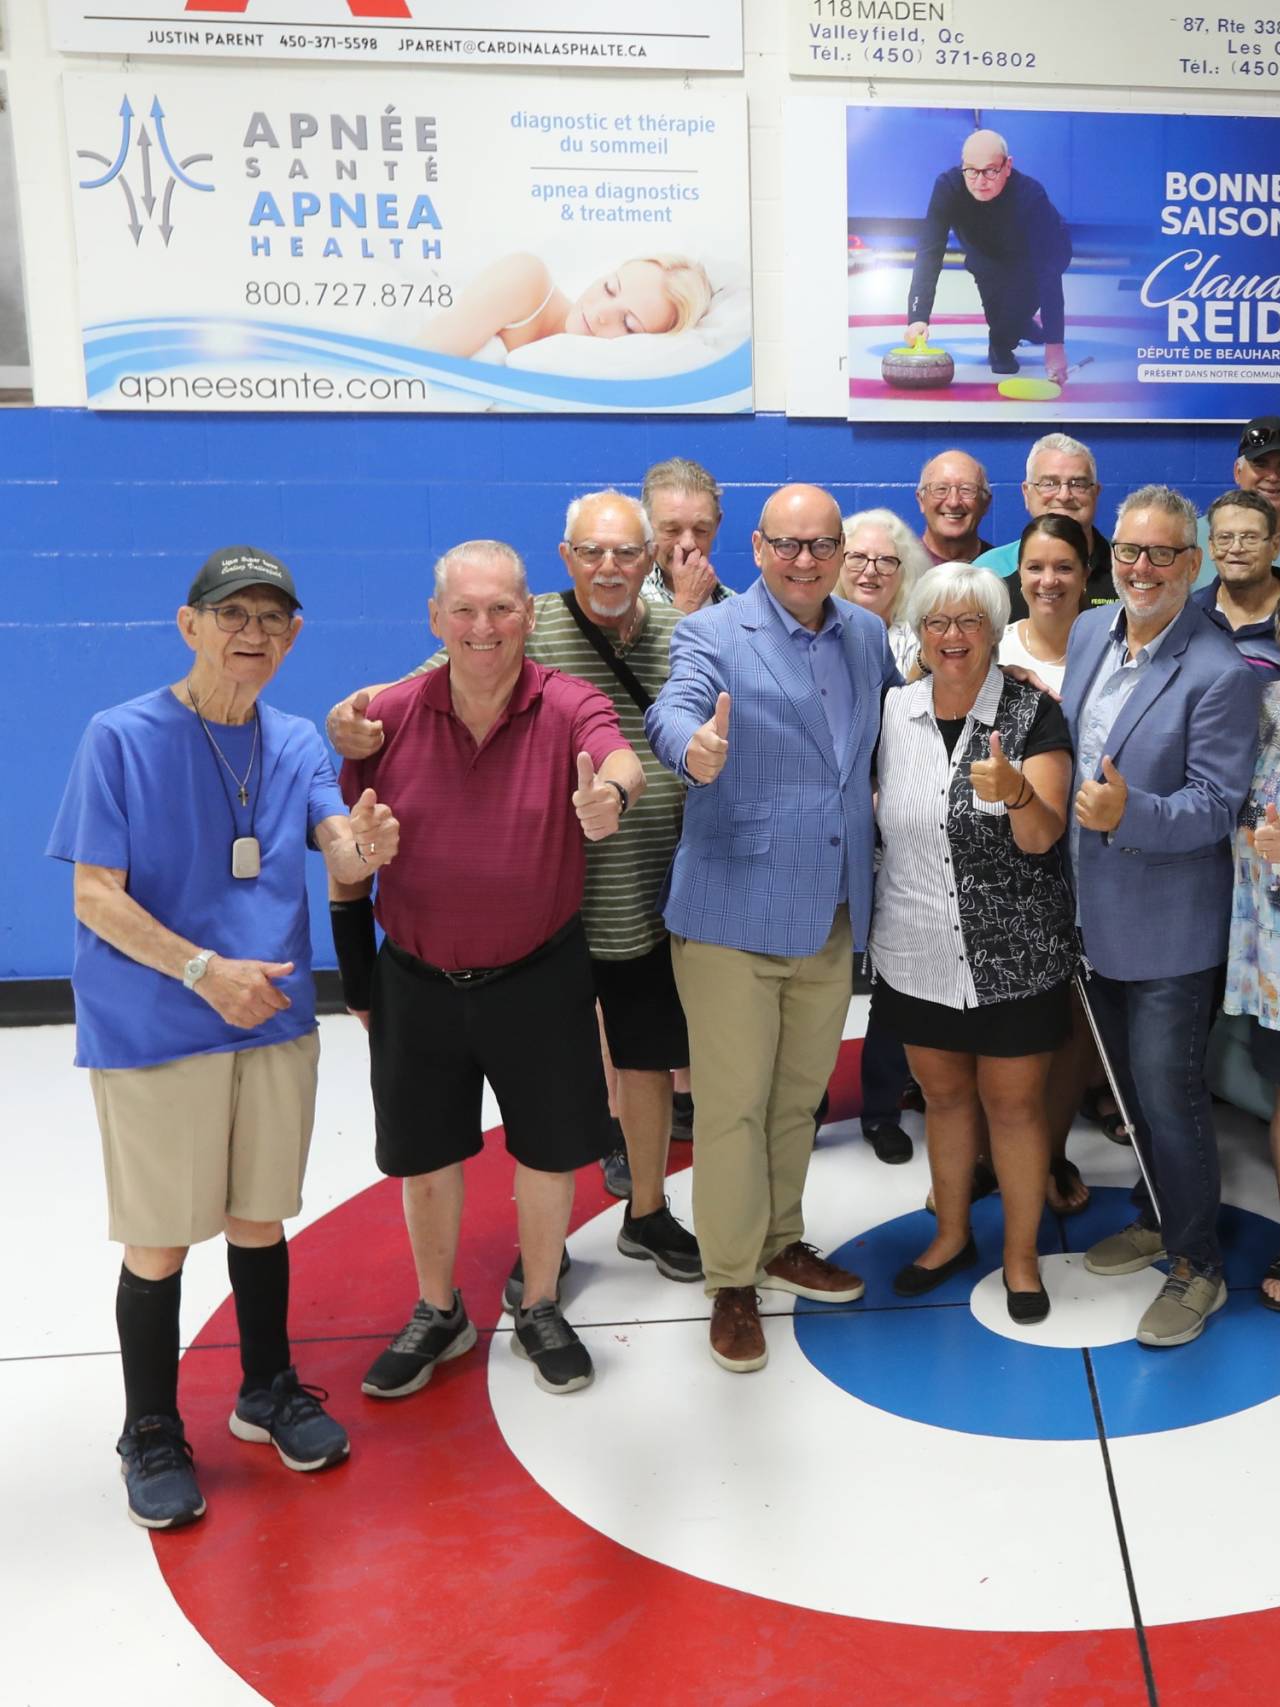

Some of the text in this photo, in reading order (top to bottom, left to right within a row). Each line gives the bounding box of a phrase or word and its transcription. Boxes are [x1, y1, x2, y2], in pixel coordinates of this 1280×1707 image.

[814, 0, 945, 21] 118 MADEN
[809, 23, 965, 44] Valleyfield, Qc
[1183, 18, 1209, 34] 87,
[1217, 18, 1246, 34] Rte
[148, 31, 648, 57] JUSTIN PARENT 450-371-5598 JPARENT@CARDINALASPHALTE.CA
[1228, 40, 1262, 54] Les
[809, 45, 1037, 68] Tél.: (450) 371-6802
[1179, 58, 1220, 74] Tél.:
[243, 104, 439, 152] APNÉE
[510, 111, 716, 136] diagnostic et thérapie
[560, 135, 669, 156] du sommeil
[245, 155, 439, 183] SANTÉ
[530, 181, 700, 204] apnea diagnostics
[248, 190, 443, 231] APNEA
[561, 204, 672, 223] & treatment
[251, 236, 443, 260] HEALTH
[244, 280, 455, 308] 800.727.8748
[1137, 346, 1190, 359] DÉPUTÉ
[1194, 348, 1212, 360] DE
[1144, 368, 1183, 378] PRÉSENT
[1184, 370, 1208, 378] DANS
[1210, 370, 1238, 378] NOTRE
[118, 372, 428, 402] apneesante.com
